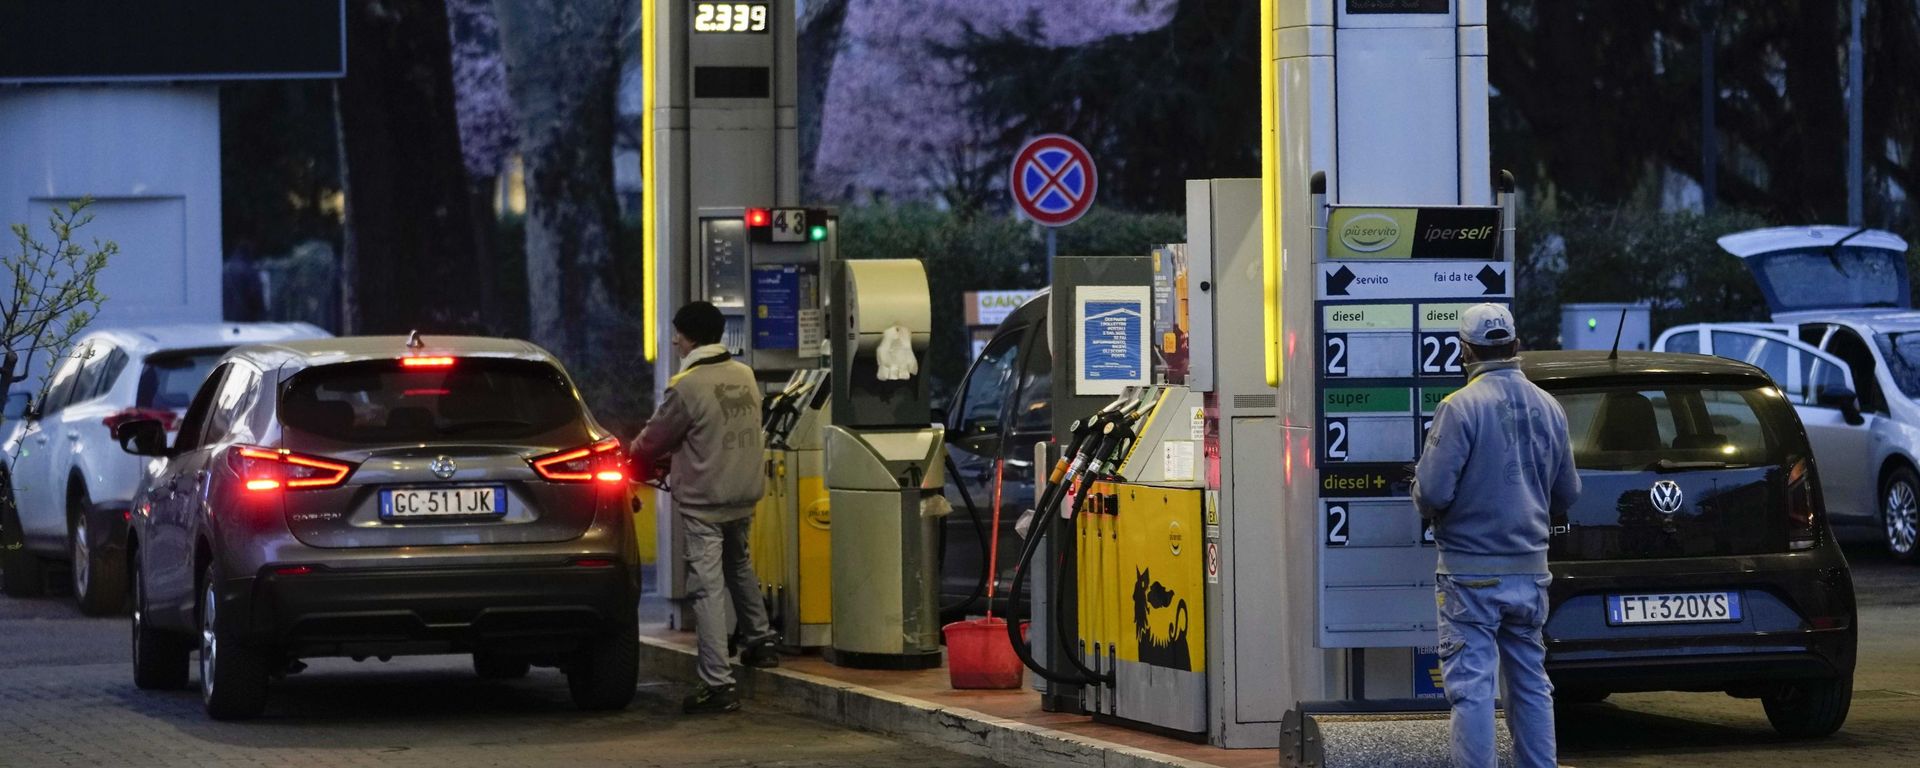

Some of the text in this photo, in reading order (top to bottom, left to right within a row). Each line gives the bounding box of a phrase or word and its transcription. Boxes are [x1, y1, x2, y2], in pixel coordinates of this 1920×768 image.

[695, 4, 767, 31] 2.339
[775, 210, 806, 235] 4 3
[1344, 225, 1397, 238] più servito
[1425, 224, 1492, 243] iperself
[1356, 275, 1389, 285] servito
[1433, 272, 1474, 283] fai da te
[1332, 311, 1364, 322] diesel
[1426, 310, 1458, 321] diesel
[1484, 314, 1506, 328] eni
[1328, 337, 1345, 374] 2
[1328, 393, 1370, 407] super
[1324, 474, 1369, 489] diesel
